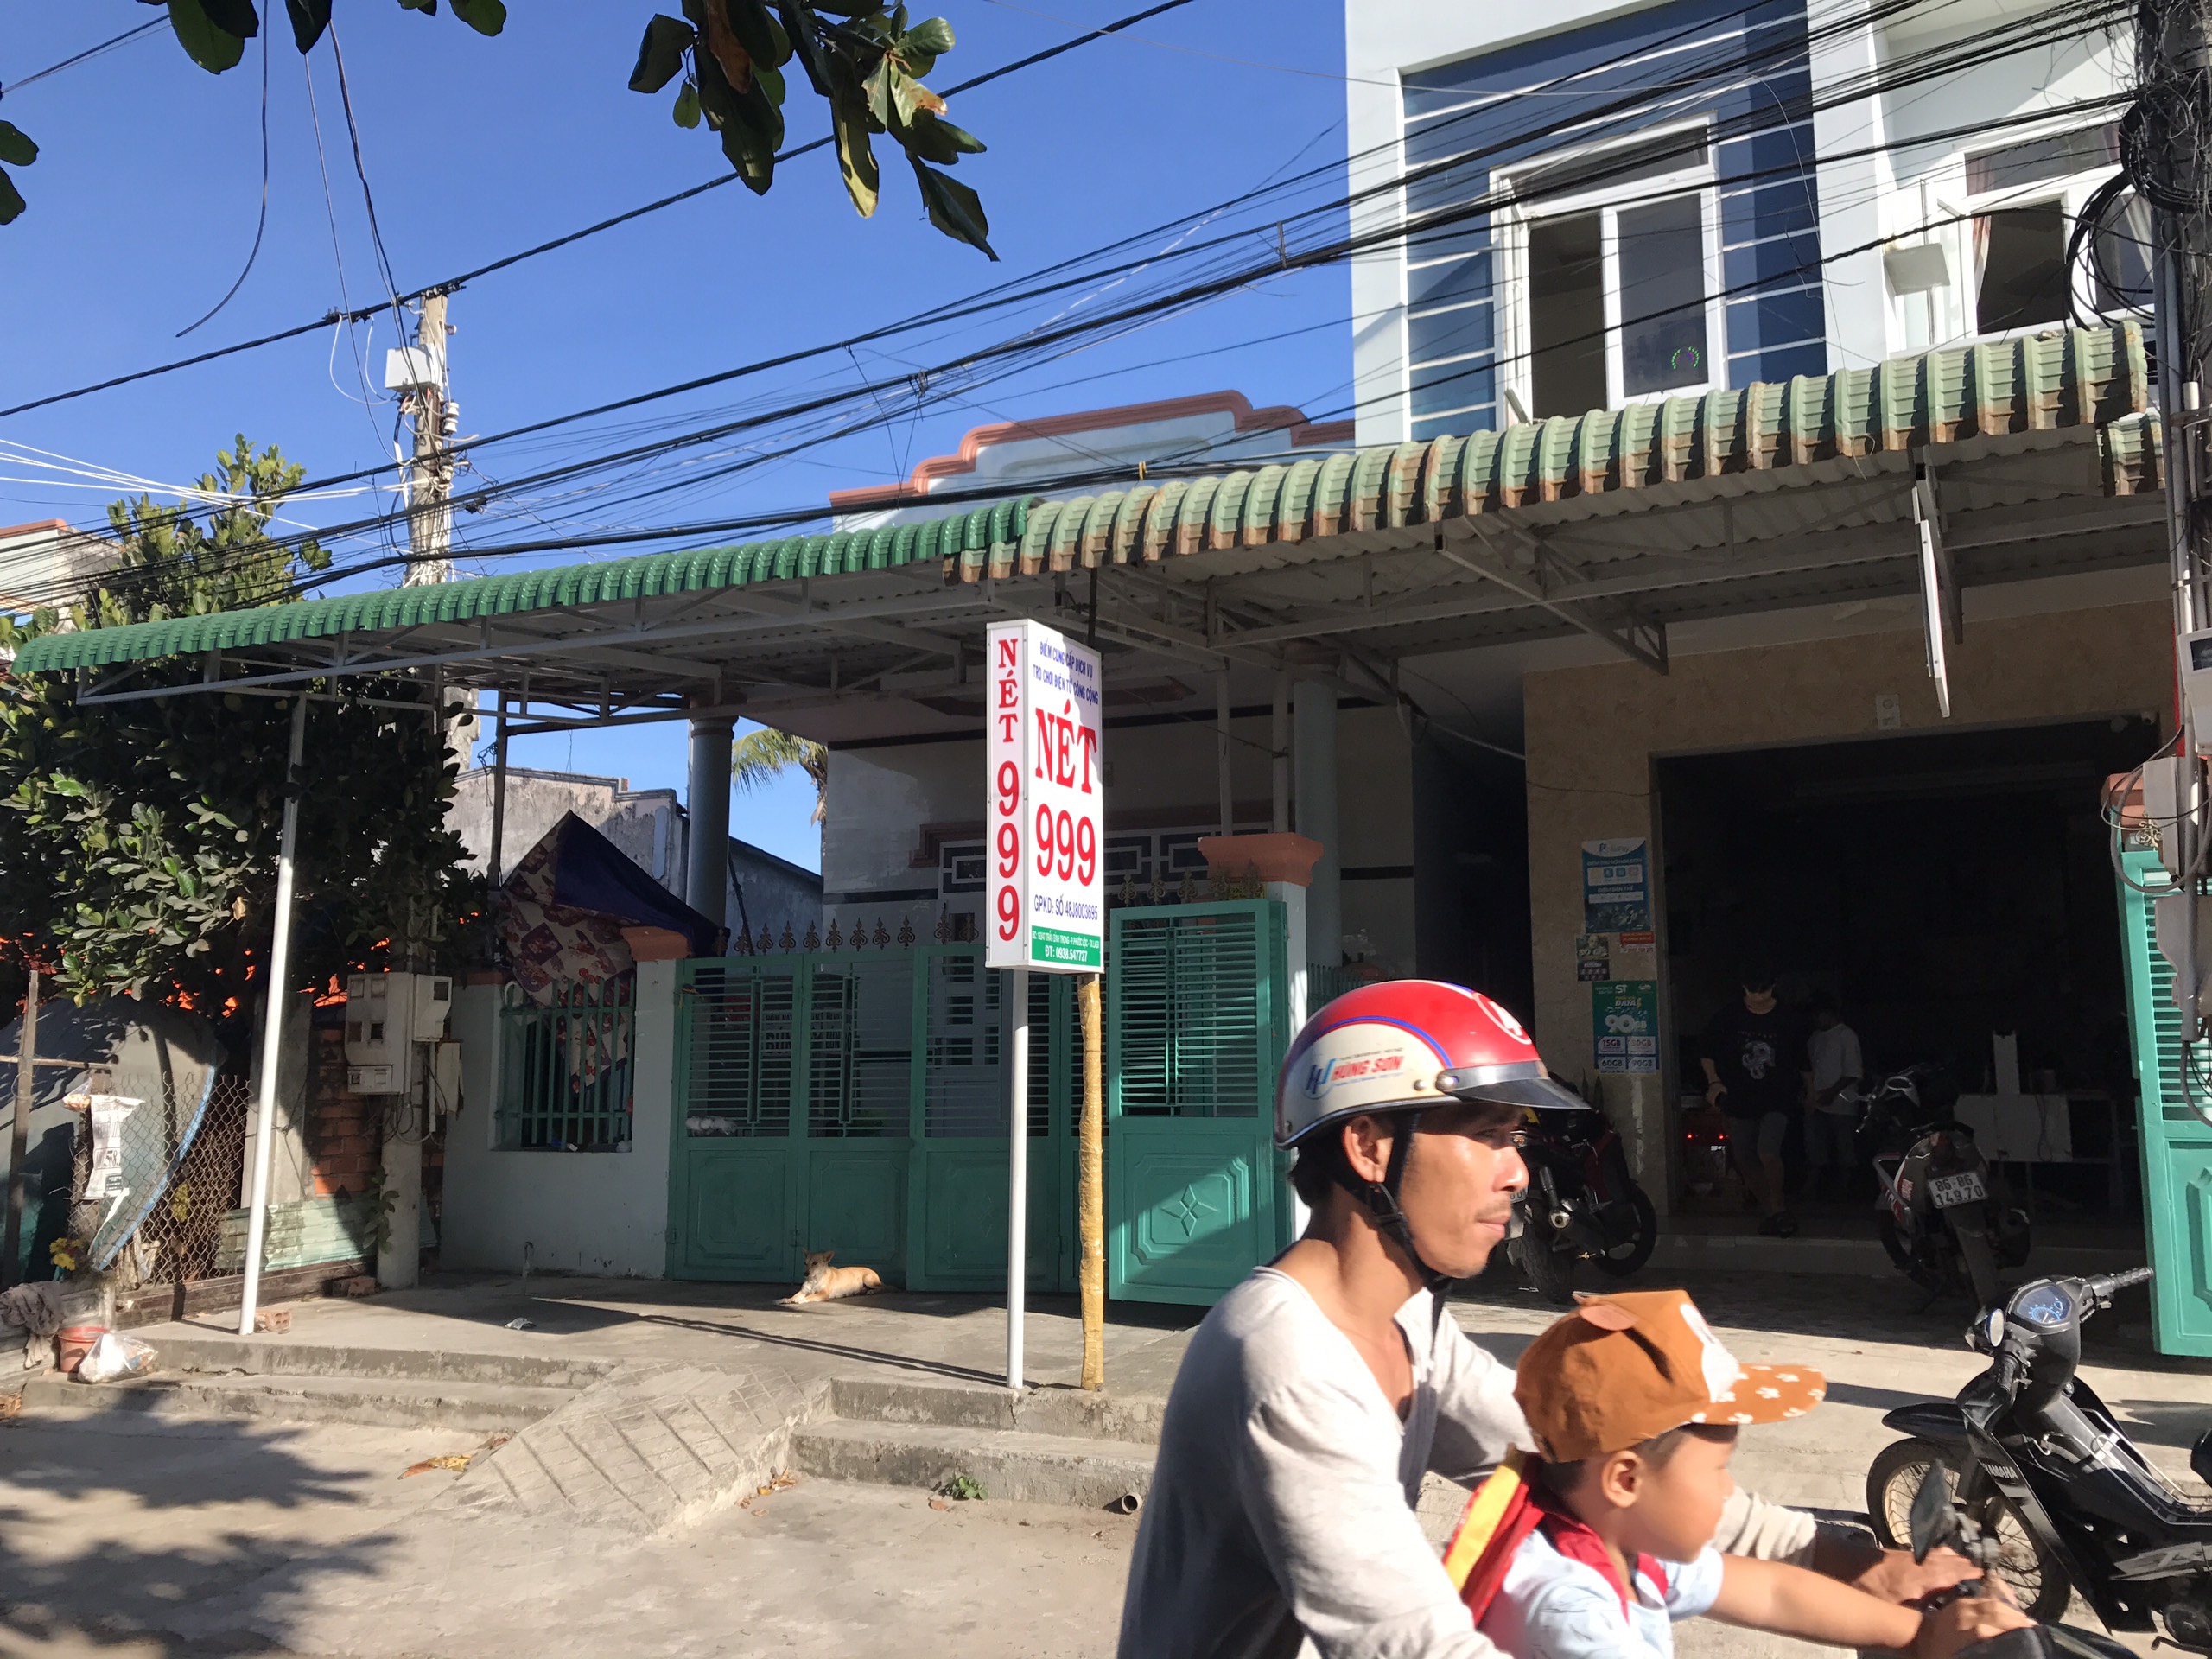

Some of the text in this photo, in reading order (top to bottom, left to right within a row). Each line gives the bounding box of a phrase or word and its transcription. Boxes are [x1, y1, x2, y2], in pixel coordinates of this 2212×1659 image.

[1052, 647, 1065, 665] CUNG
[1065, 650, 1075, 670] CẤP
[1076, 658, 1086, 676] DỊCH
[1086, 663, 1093, 681] VỤ
[998, 638, 1019, 743] NÉT
[1073, 680, 1085, 700] CÔNG
[1086, 685, 1099, 706] CỘNG
[1035, 698, 1097, 795] NÉT
[996, 760, 1020, 942] 999
[1036, 803, 1096, 887] 999
[1034, 894, 1054, 914] GPKD:
[1055, 893, 1064, 917] SỐ
[1045, 944, 1088, 962] ĐT: 0938.547727
[1982, 1462, 2019, 1479] YAMAHA
